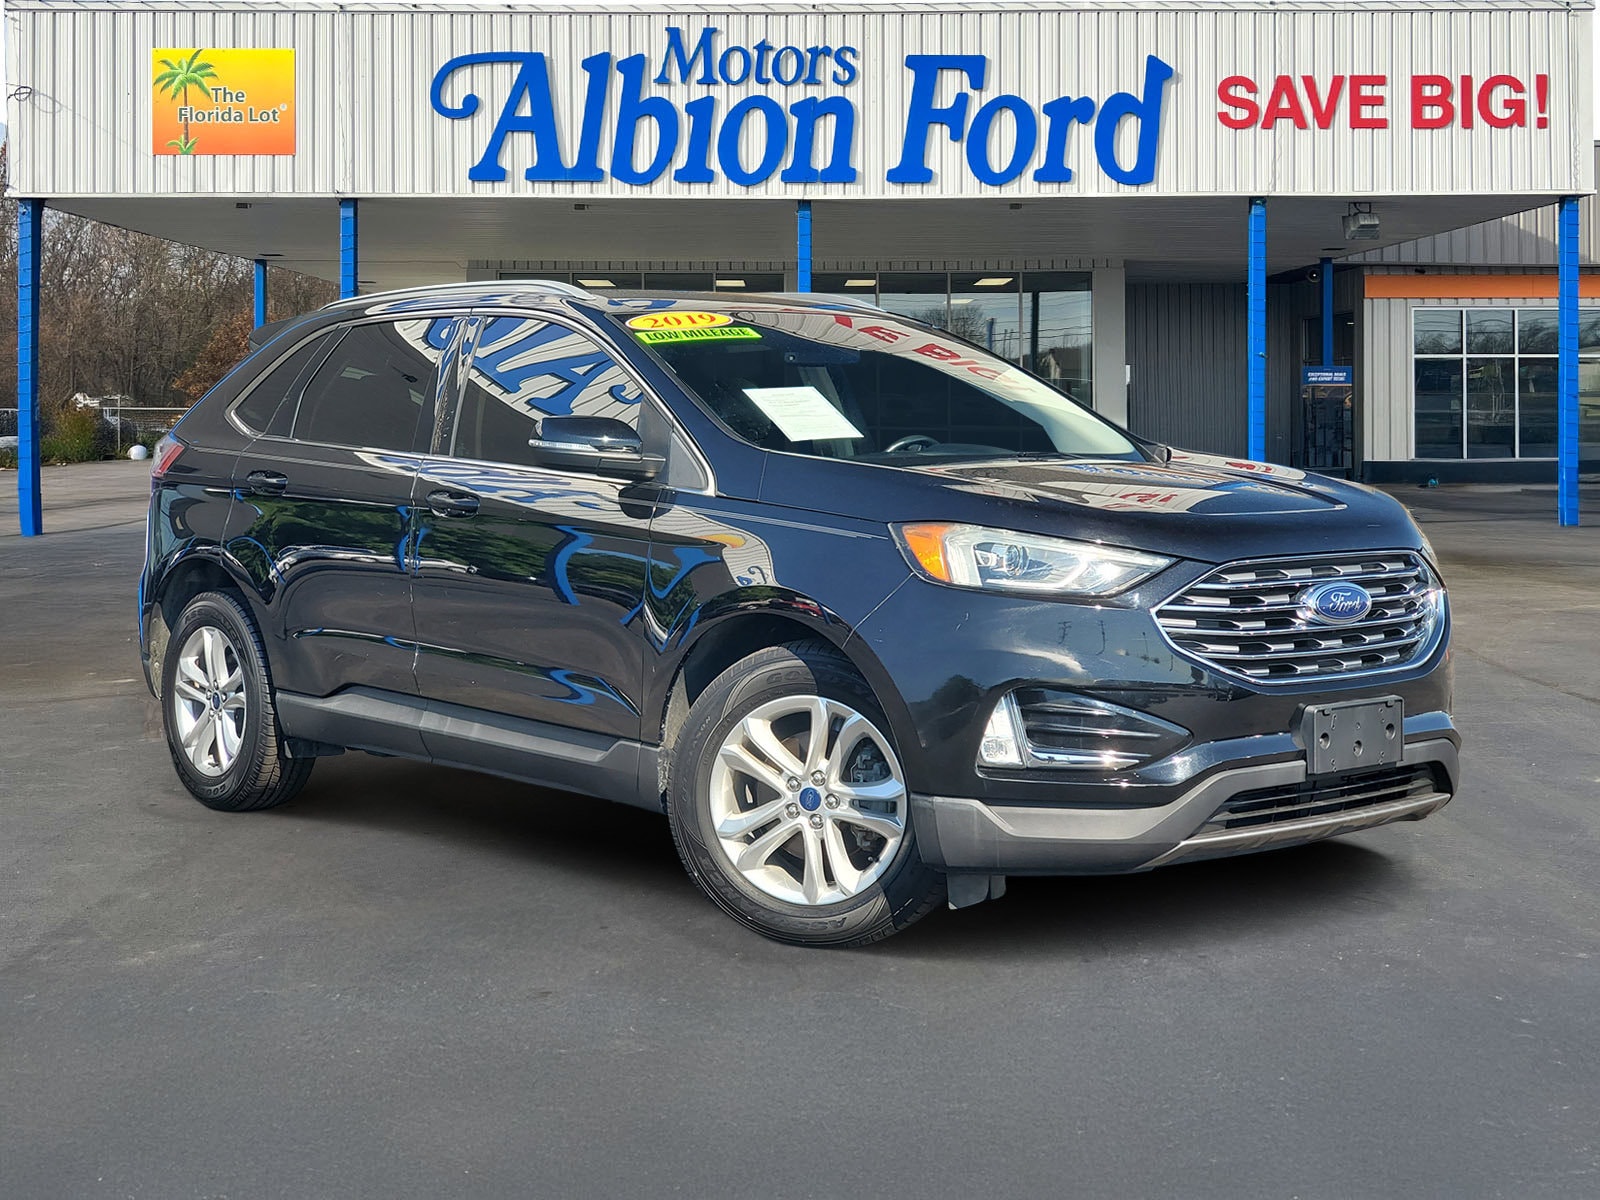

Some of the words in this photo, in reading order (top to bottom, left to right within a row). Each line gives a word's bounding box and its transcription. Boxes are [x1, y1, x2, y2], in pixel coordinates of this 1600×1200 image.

[653, 27, 858, 86] Motors
[211, 86, 246, 103] The
[1216, 74, 1389, 130] SAVE
[1410, 73, 1549, 130] BIG!
[177, 106, 244, 123] Florida
[248, 106, 280, 123] Lot
[430, 51, 857, 187] Albion
[887, 54, 1175, 187] Ford
[642, 313, 717, 329] 2019
[644, 330, 680, 342] LOW
[680, 327, 750, 340] MILEAGE
[1329, 591, 1362, 612] Ford
